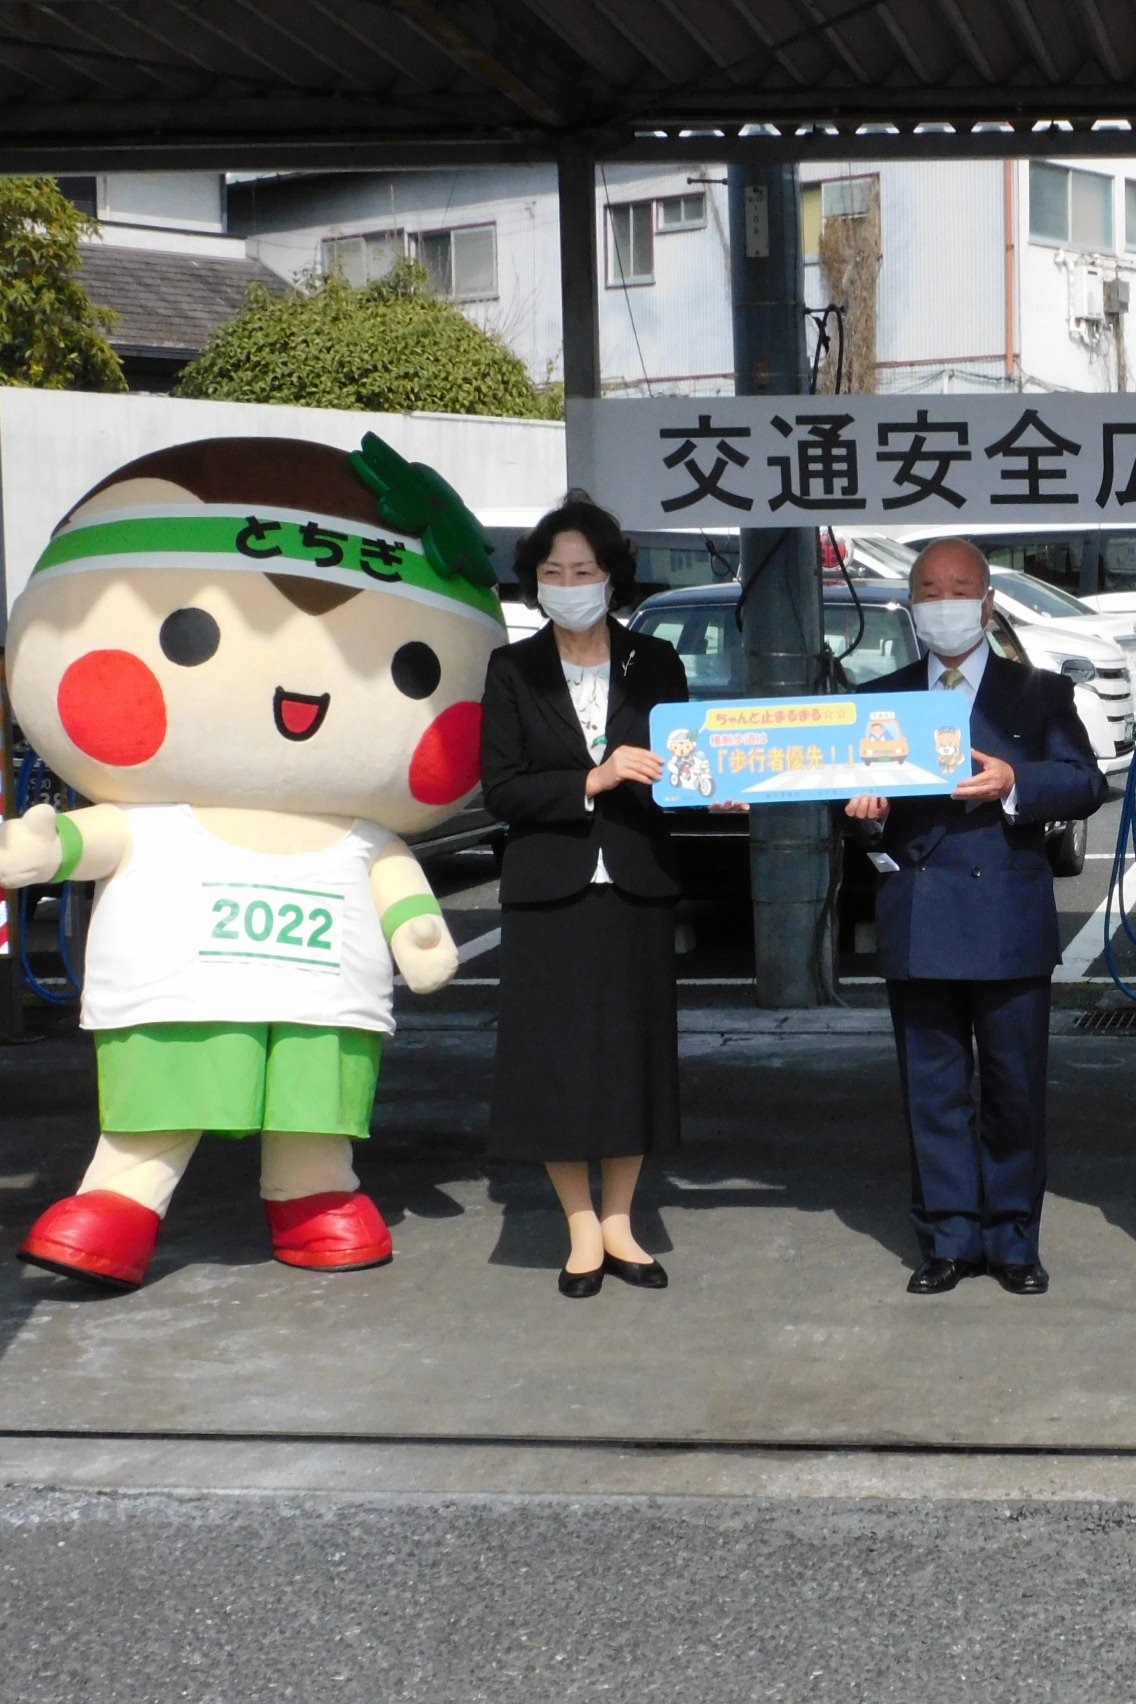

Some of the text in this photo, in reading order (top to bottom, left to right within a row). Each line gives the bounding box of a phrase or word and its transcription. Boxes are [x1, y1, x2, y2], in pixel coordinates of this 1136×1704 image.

[235, 515, 406, 583] とちぎ
[211, 898, 333, 951] 2022
